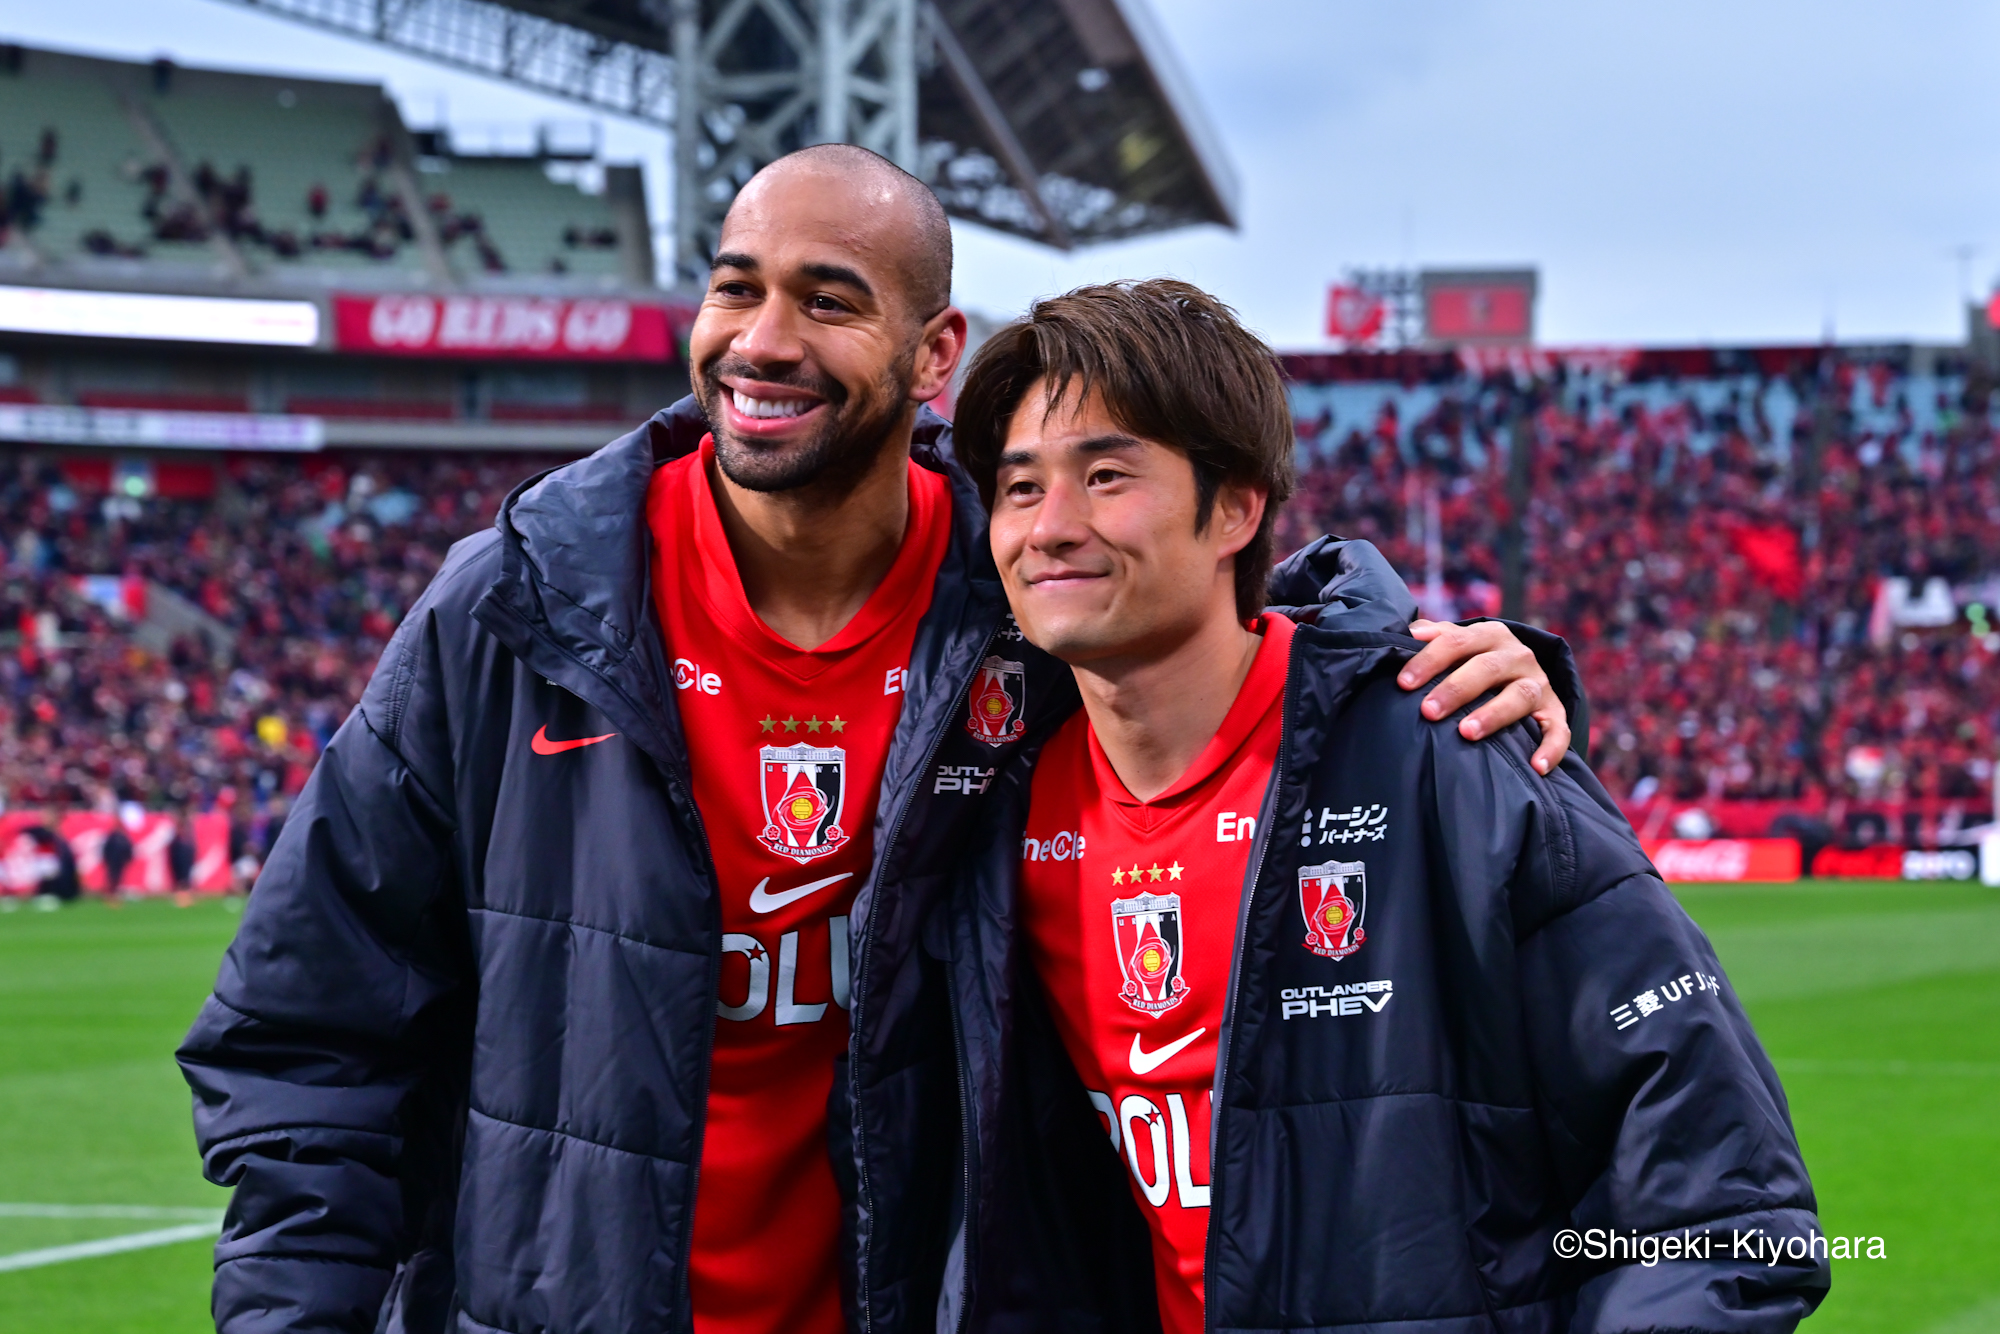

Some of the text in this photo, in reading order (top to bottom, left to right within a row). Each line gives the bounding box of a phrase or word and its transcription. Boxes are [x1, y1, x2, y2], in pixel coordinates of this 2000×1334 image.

[670, 658, 722, 695] Cle
[936, 764, 999, 777] OUTLA
[933, 777, 993, 796] PH
[1318, 803, 1388, 829] トーシン
[1318, 823, 1388, 845] パートナーズ
[773, 842, 834, 857] RED DIAMONDS
[1021, 830, 1087, 862] neCle
[1280, 980, 1393, 1000] OUTLANDER
[1146, 996, 1179, 1010] DIAMONDS
[1281, 992, 1394, 1020] PHEV
